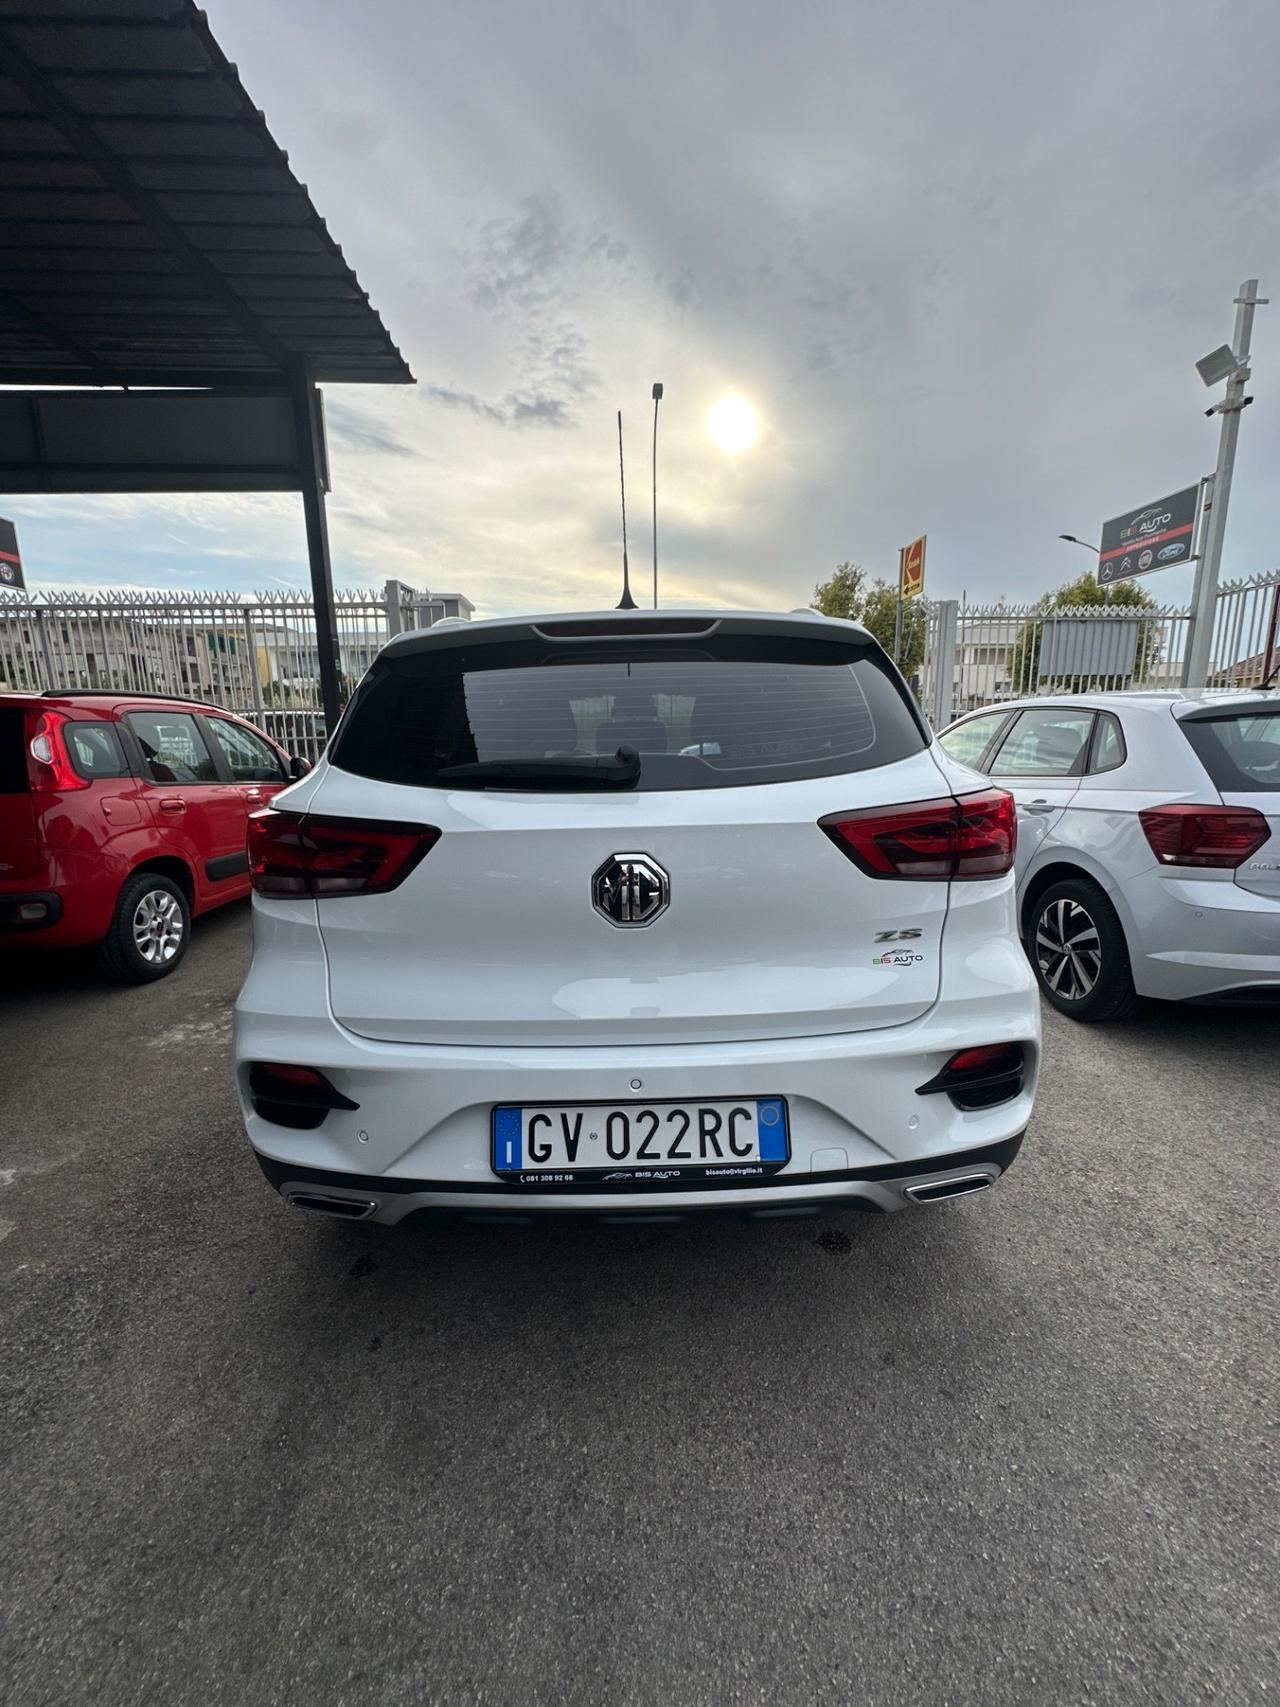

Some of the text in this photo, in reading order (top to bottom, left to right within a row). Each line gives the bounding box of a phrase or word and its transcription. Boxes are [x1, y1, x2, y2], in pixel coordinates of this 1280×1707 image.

[1139, 513, 1172, 532] AUTO
[599, 862, 661, 922] MG
[874, 929, 923, 943] ZS
[872, 955, 924, 965] BIS AUTO
[528, 1113, 583, 1163] GV
[606, 1107, 753, 1160] 022RC
[653, 1170, 681, 1178] AUTO
